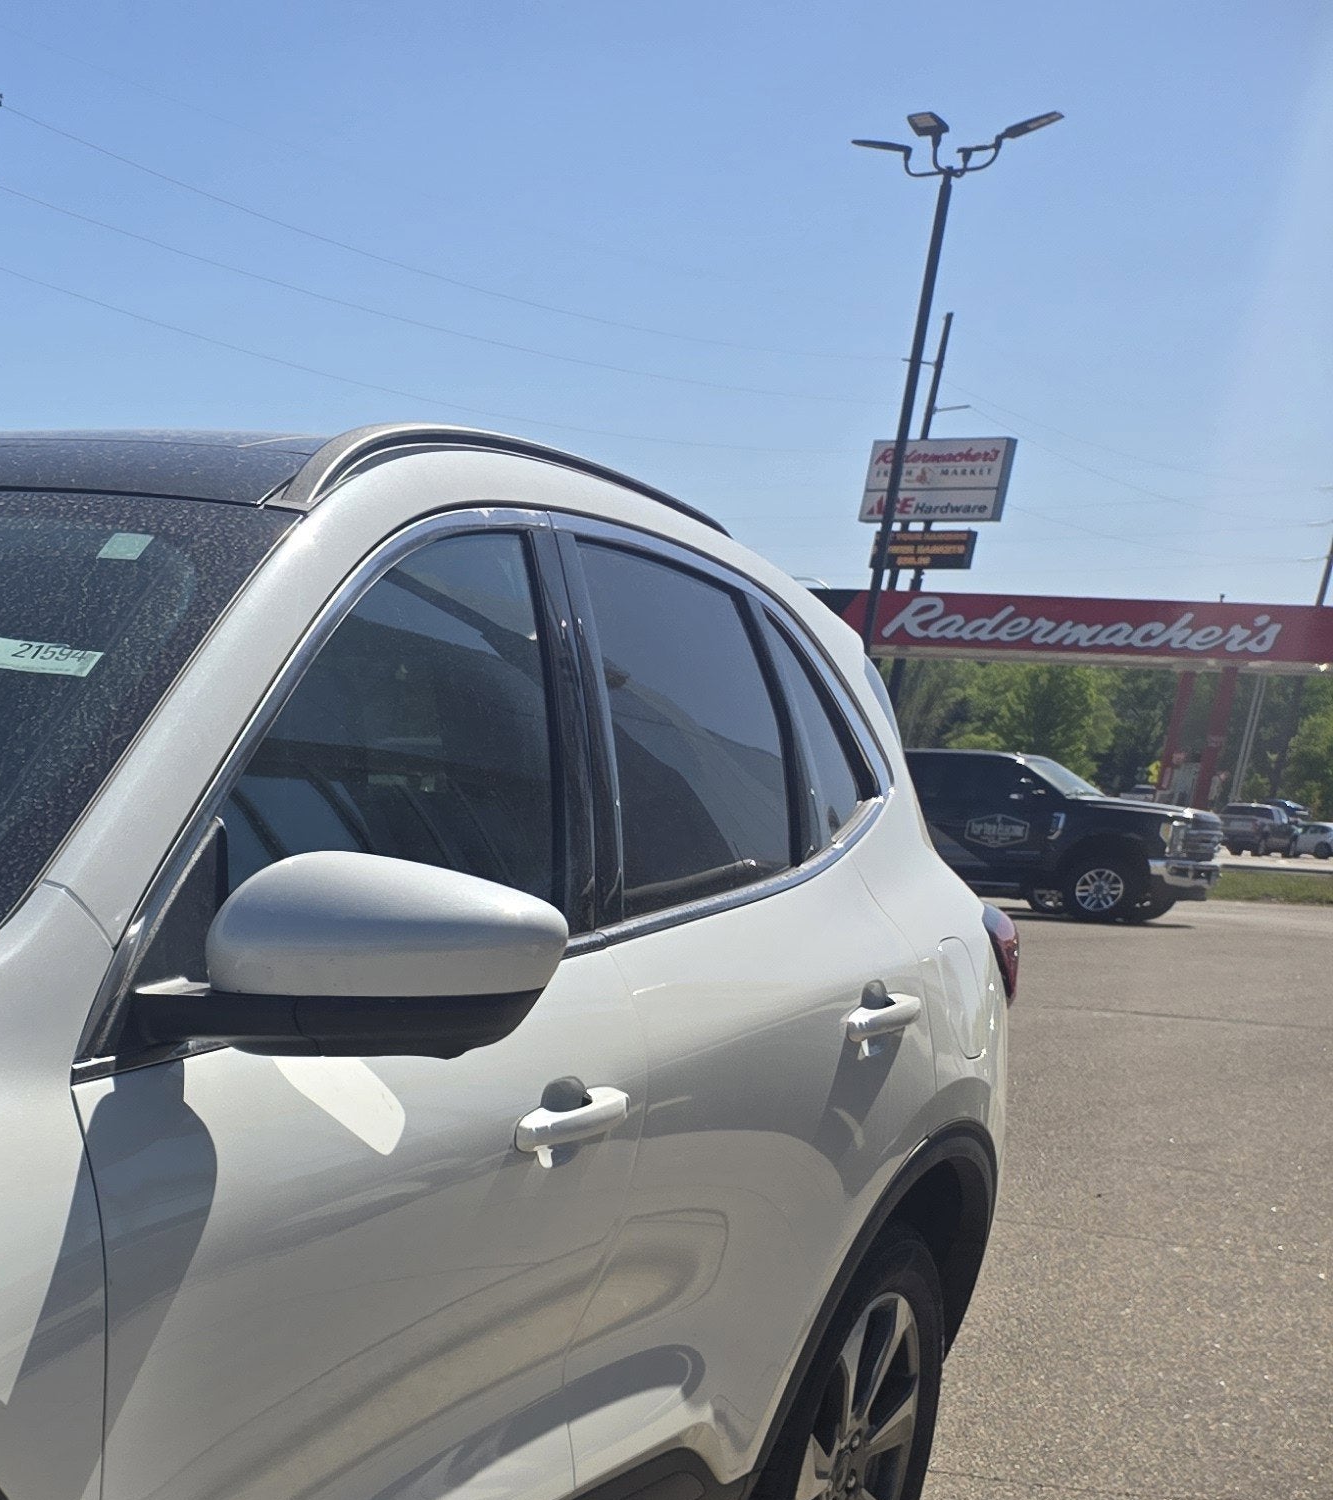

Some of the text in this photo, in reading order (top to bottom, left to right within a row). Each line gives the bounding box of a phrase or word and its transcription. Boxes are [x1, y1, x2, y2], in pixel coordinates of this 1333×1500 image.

[874, 447, 1000, 465] Rdermacher's
[876, 468, 992, 478] FRH MARKET
[866, 495, 988, 515] AE Hardware
[882, 596, 1282, 653] Radermacher's
[11, 643, 85, 661] 21594
